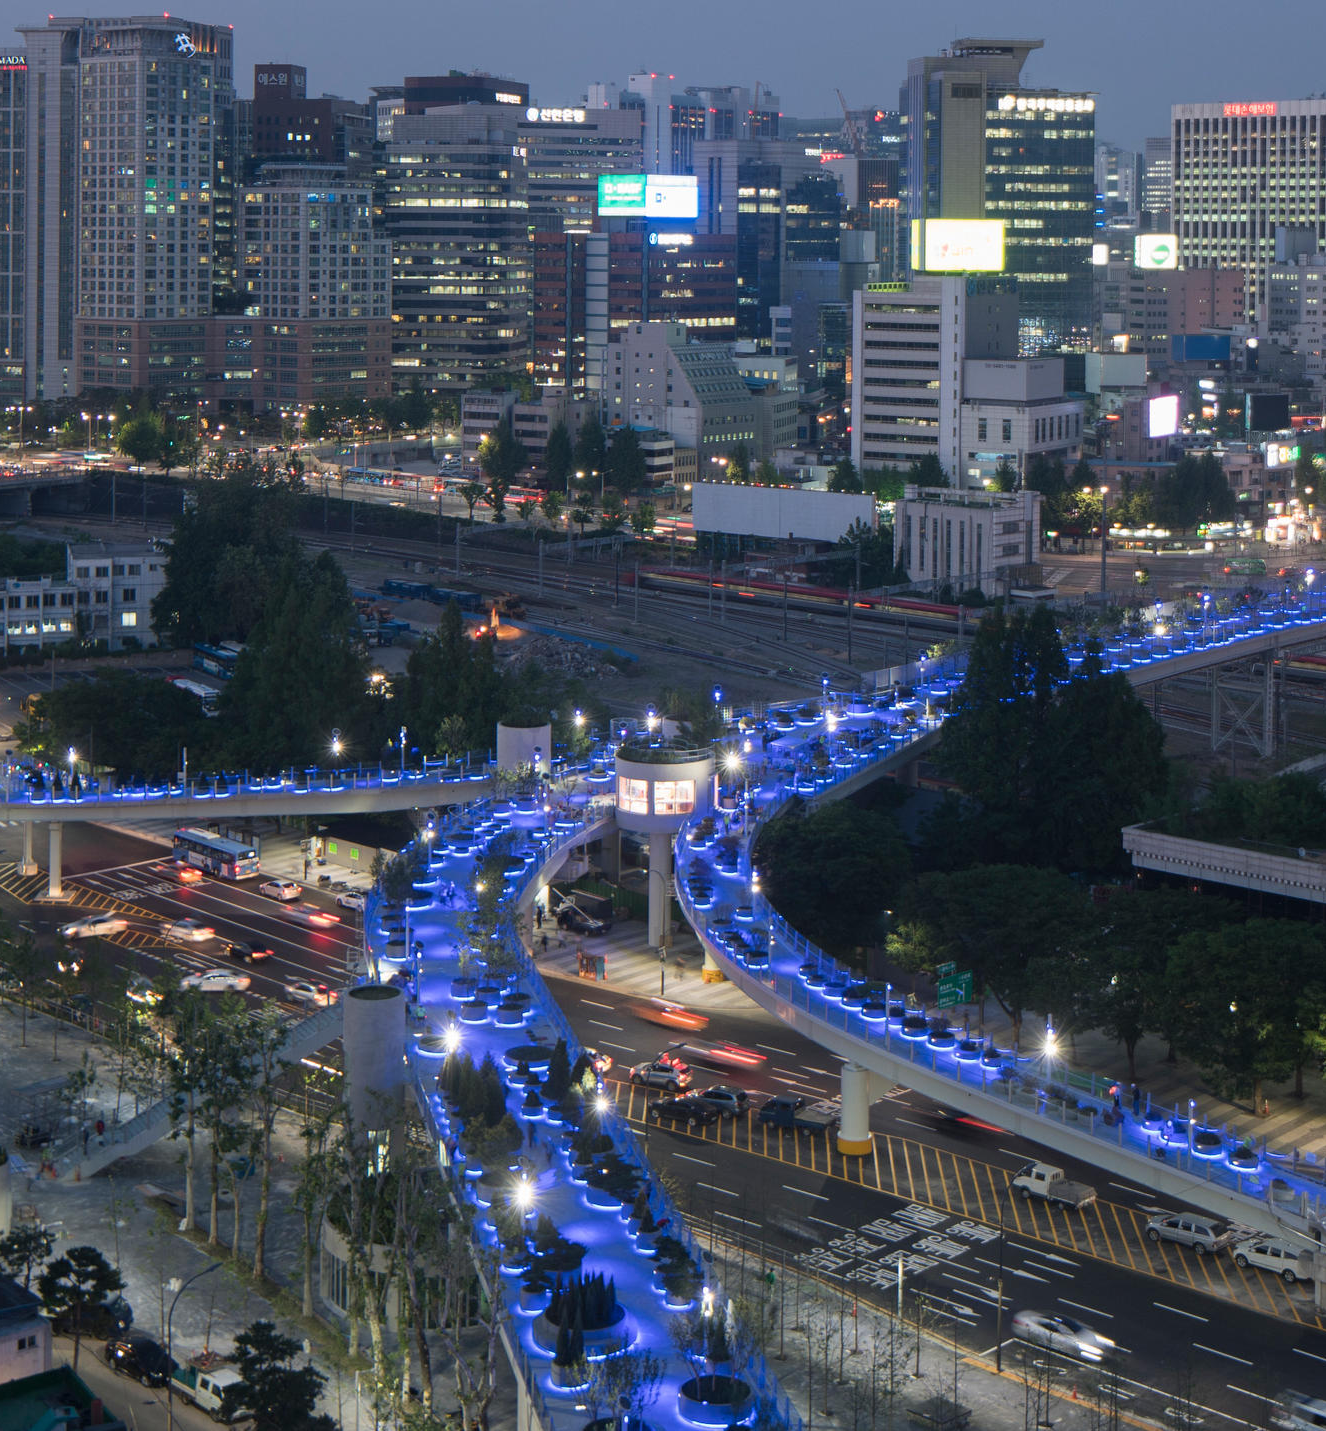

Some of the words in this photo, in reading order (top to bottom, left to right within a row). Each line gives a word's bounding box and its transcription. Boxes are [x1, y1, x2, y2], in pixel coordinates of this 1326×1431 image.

[258, 73, 287, 86] 에스원
[540, 109, 585, 122] 신한은행
[1224, 103, 1277, 116] 롯데손해보험
[617, 183, 641, 193] BASF
